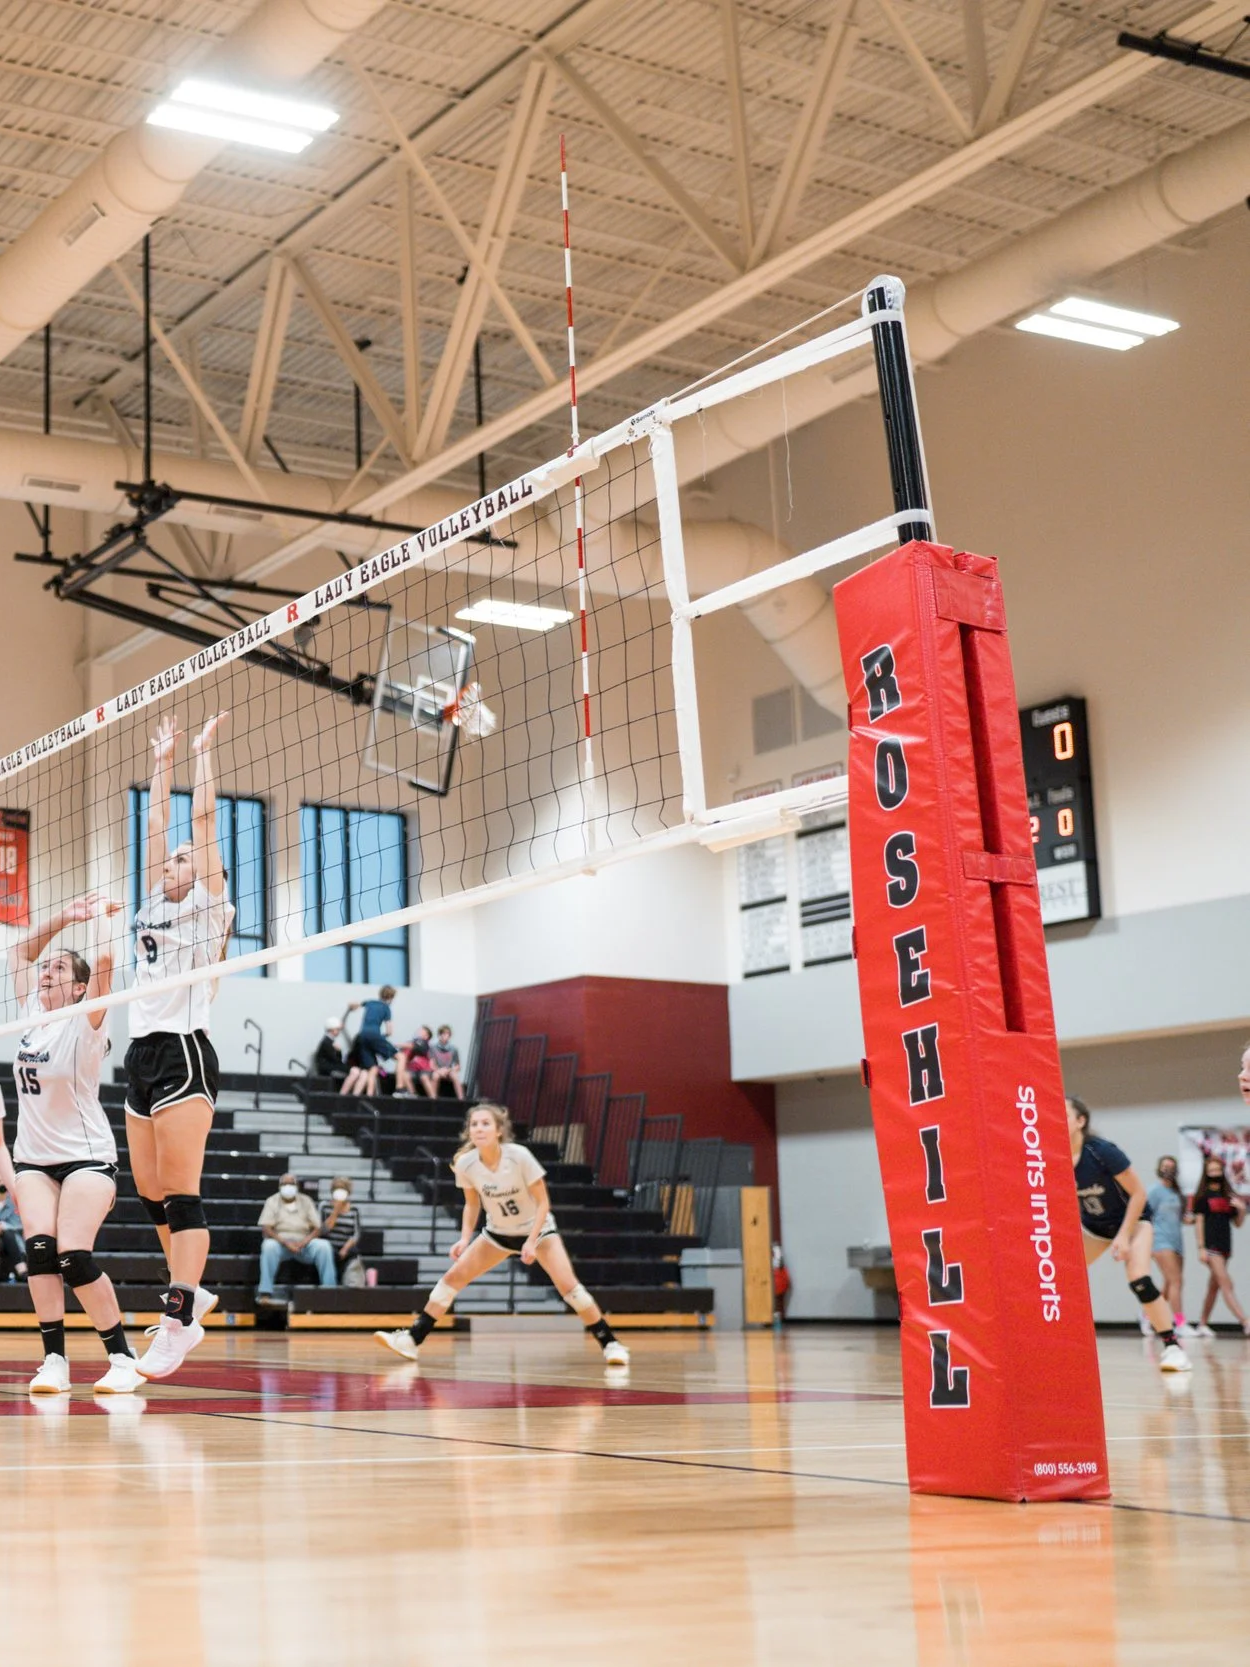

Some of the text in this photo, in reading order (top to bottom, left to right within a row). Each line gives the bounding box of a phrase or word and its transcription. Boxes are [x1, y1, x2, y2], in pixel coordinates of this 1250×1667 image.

[25, 717, 86, 761] VOLLEYBALL
[96, 706, 105, 724] R
[116, 684, 145, 713] LADY
[150, 665, 185, 695] EAGLE
[190, 618, 271, 673] VOLLEYBALL
[286, 602, 299, 624] R
[314, 572, 353, 608] LADY
[361, 542, 410, 584] EAGLE
[417, 478, 533, 552] VOLLEYBALL
[1053, 722, 1075, 760] 0
[1057, 808, 1075, 837] 0
[141, 935, 158, 964] 9
[861, 643, 970, 1409] ROSEHILL
[18, 1066, 41, 1095] 15
[1016, 1084, 1062, 1323] sports imports
[1034, 1462, 1098, 1476] (800) 556-3198
